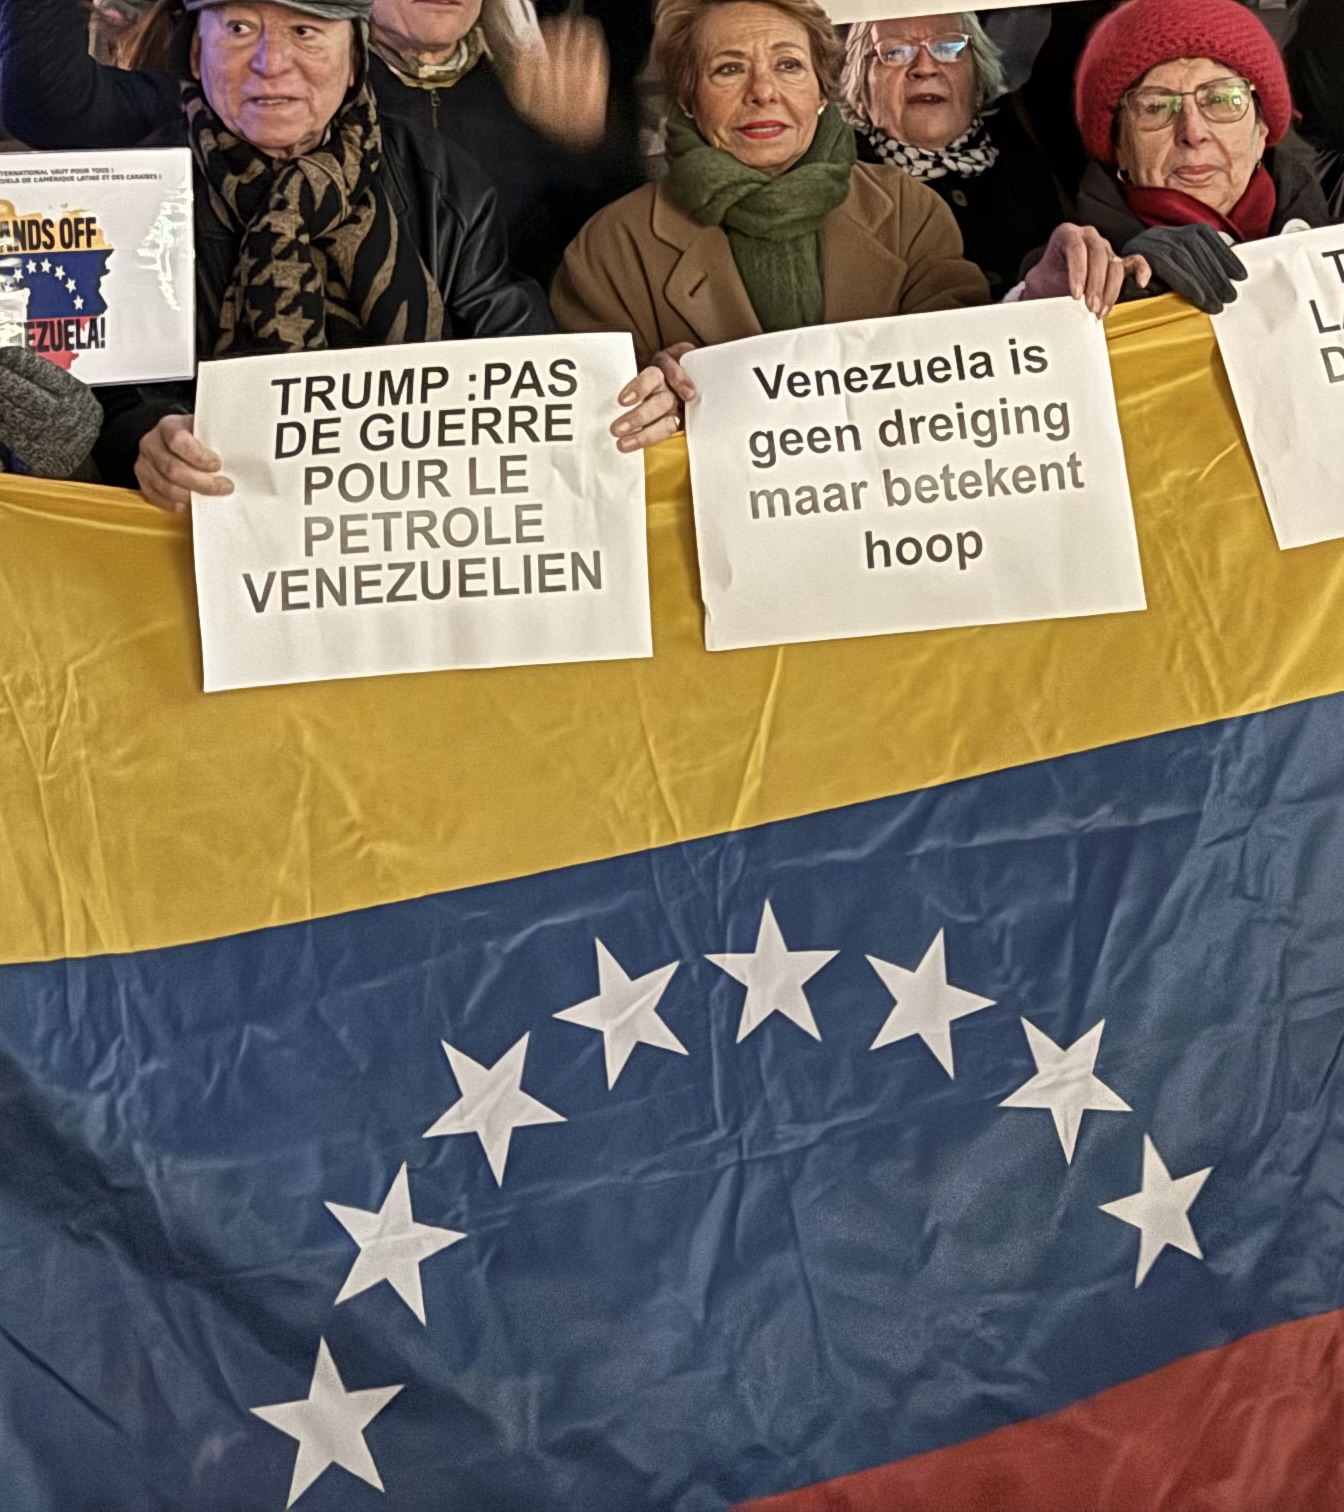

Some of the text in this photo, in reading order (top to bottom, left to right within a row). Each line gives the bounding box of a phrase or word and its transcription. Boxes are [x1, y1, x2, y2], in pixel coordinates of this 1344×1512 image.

[60, 217, 97, 249] OFF
[270, 365, 450, 417] TRUMP
[752, 338, 1050, 401] Venezuela is
[274, 403, 574, 460] DE GUERRE
[748, 397, 1072, 469] geen dreiging
[303, 454, 529, 507] POUR LE
[748, 451, 1085, 520] maar betekent
[303, 503, 546, 558] PETROLE
[864, 528, 984, 571] hoop
[241, 550, 603, 614] VENEZUELIEN
